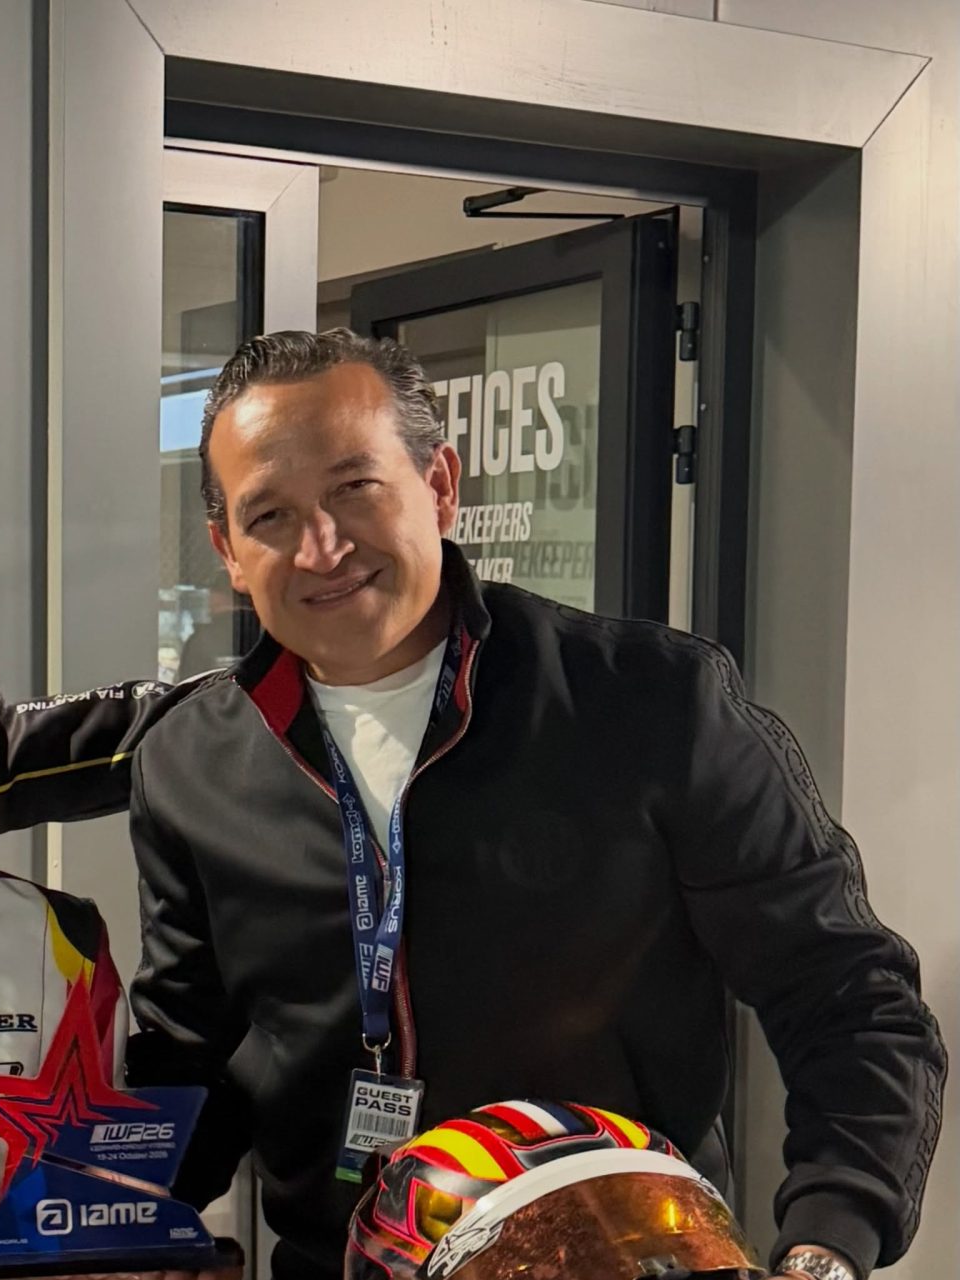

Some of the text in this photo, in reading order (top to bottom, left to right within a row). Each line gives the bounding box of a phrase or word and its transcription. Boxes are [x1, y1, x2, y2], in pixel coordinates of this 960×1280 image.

[389, 865, 403, 934] KORUS
[356, 1086, 413, 1104] GUEST
[354, 1097, 411, 1117] PASS
